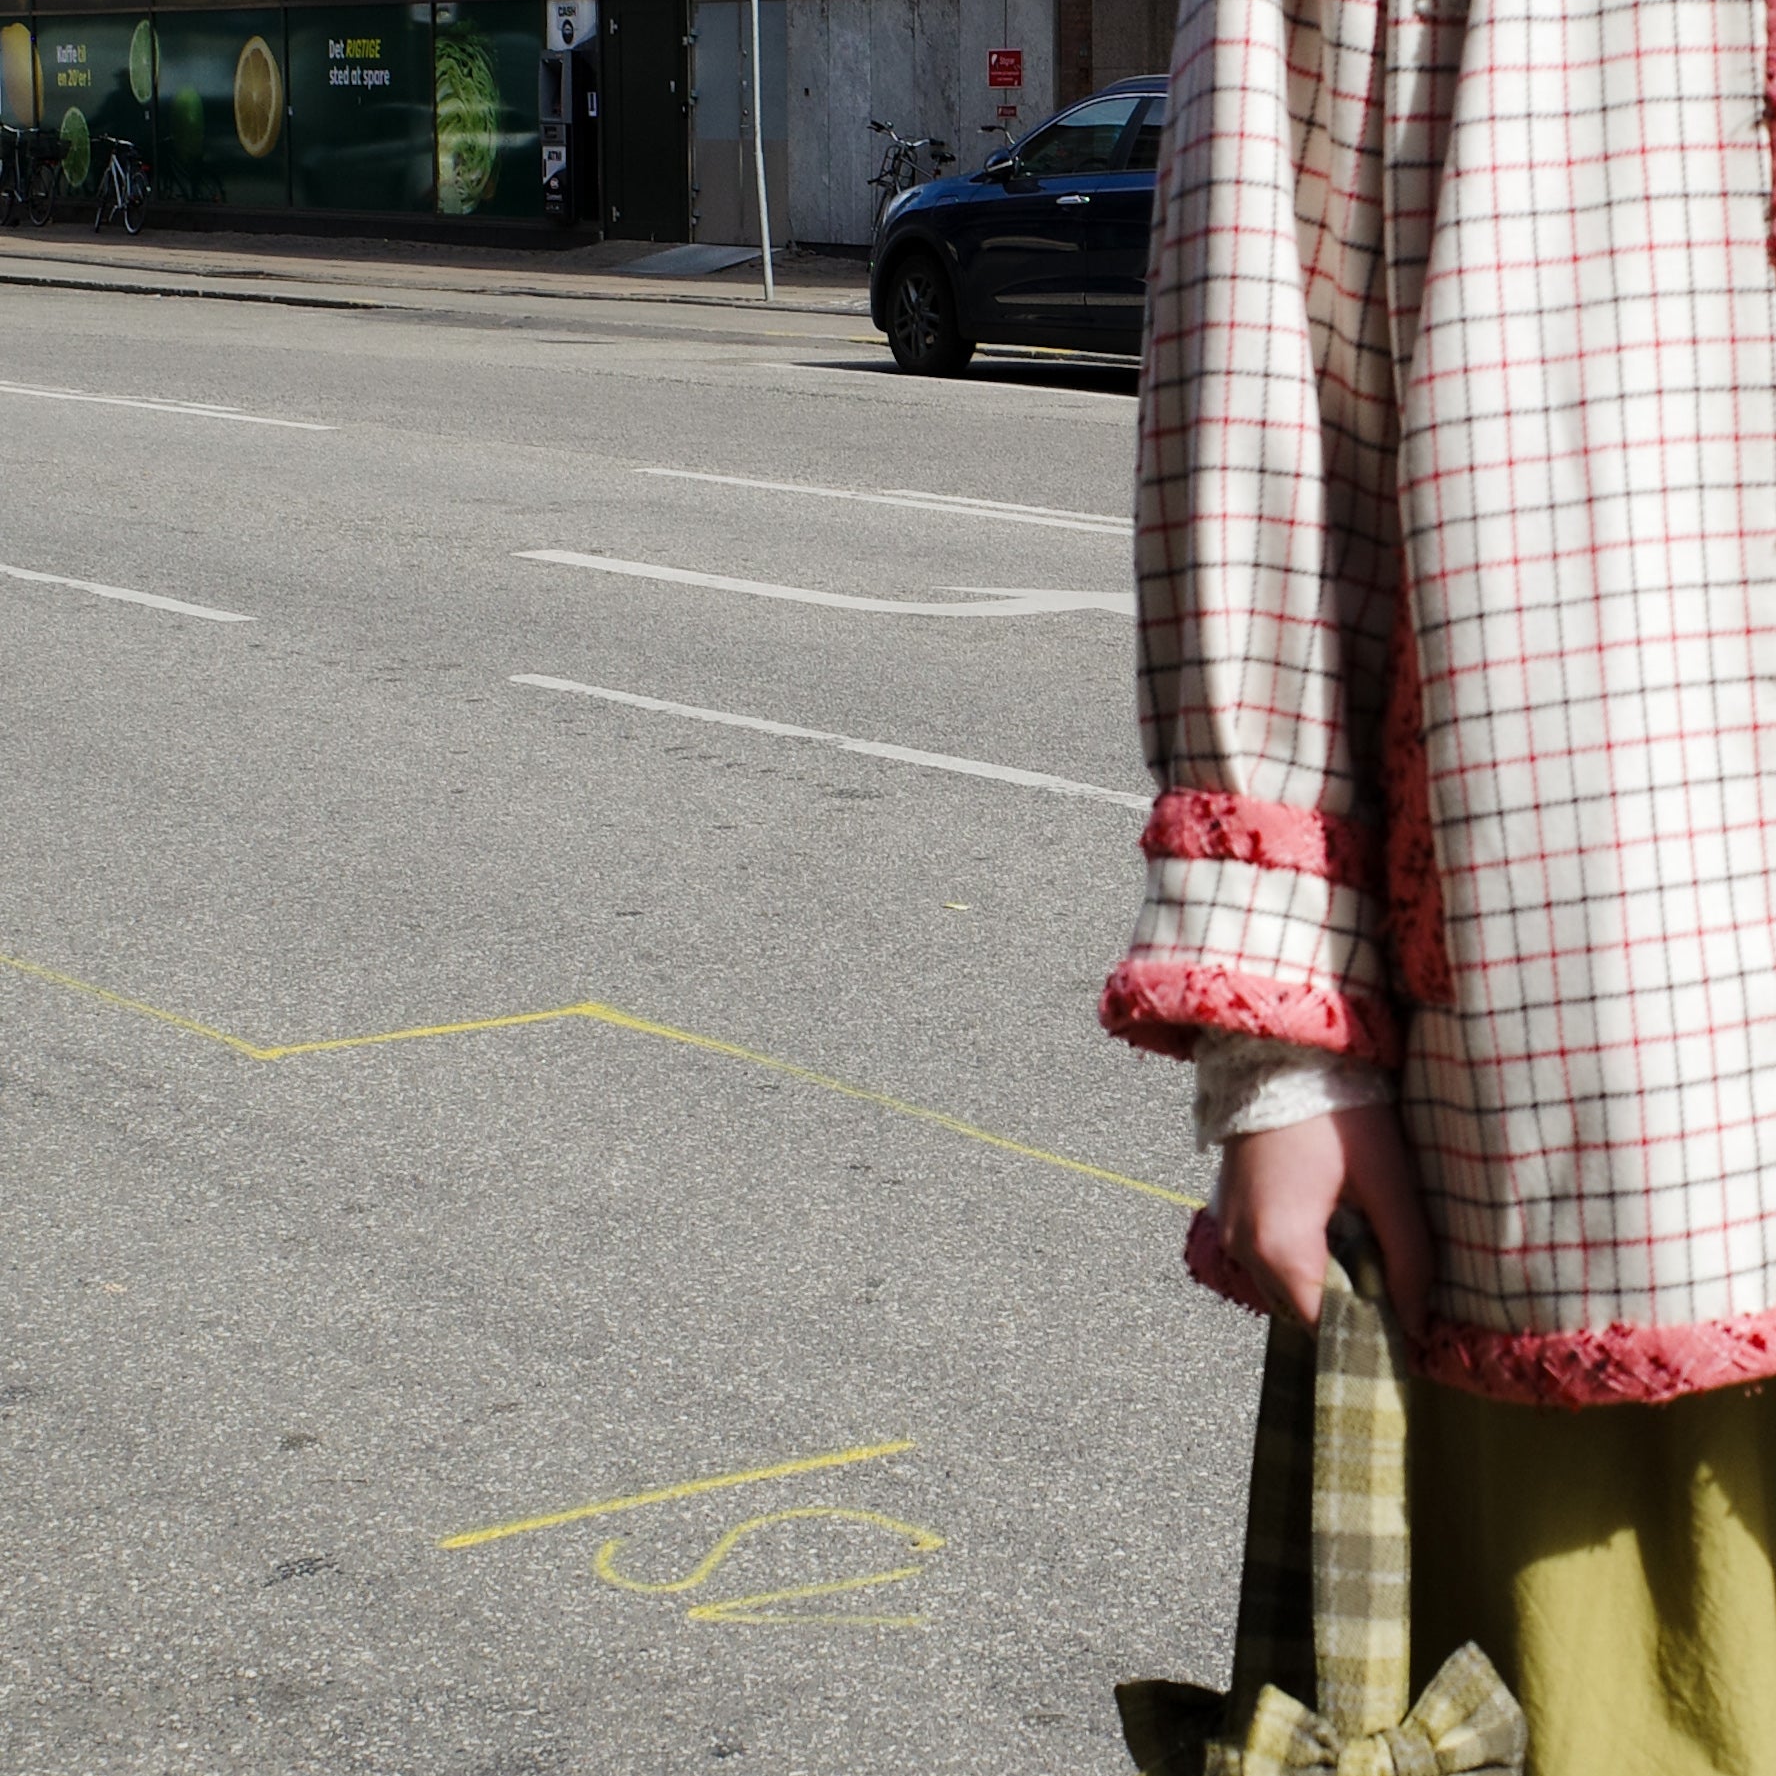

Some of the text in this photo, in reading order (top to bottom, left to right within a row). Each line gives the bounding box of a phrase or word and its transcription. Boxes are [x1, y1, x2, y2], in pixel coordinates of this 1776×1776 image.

[557, 6, 577, 18] CASH
[328, 38, 381, 59] Det RIGTIGE
[328, 65, 391, 90] sted at spare
